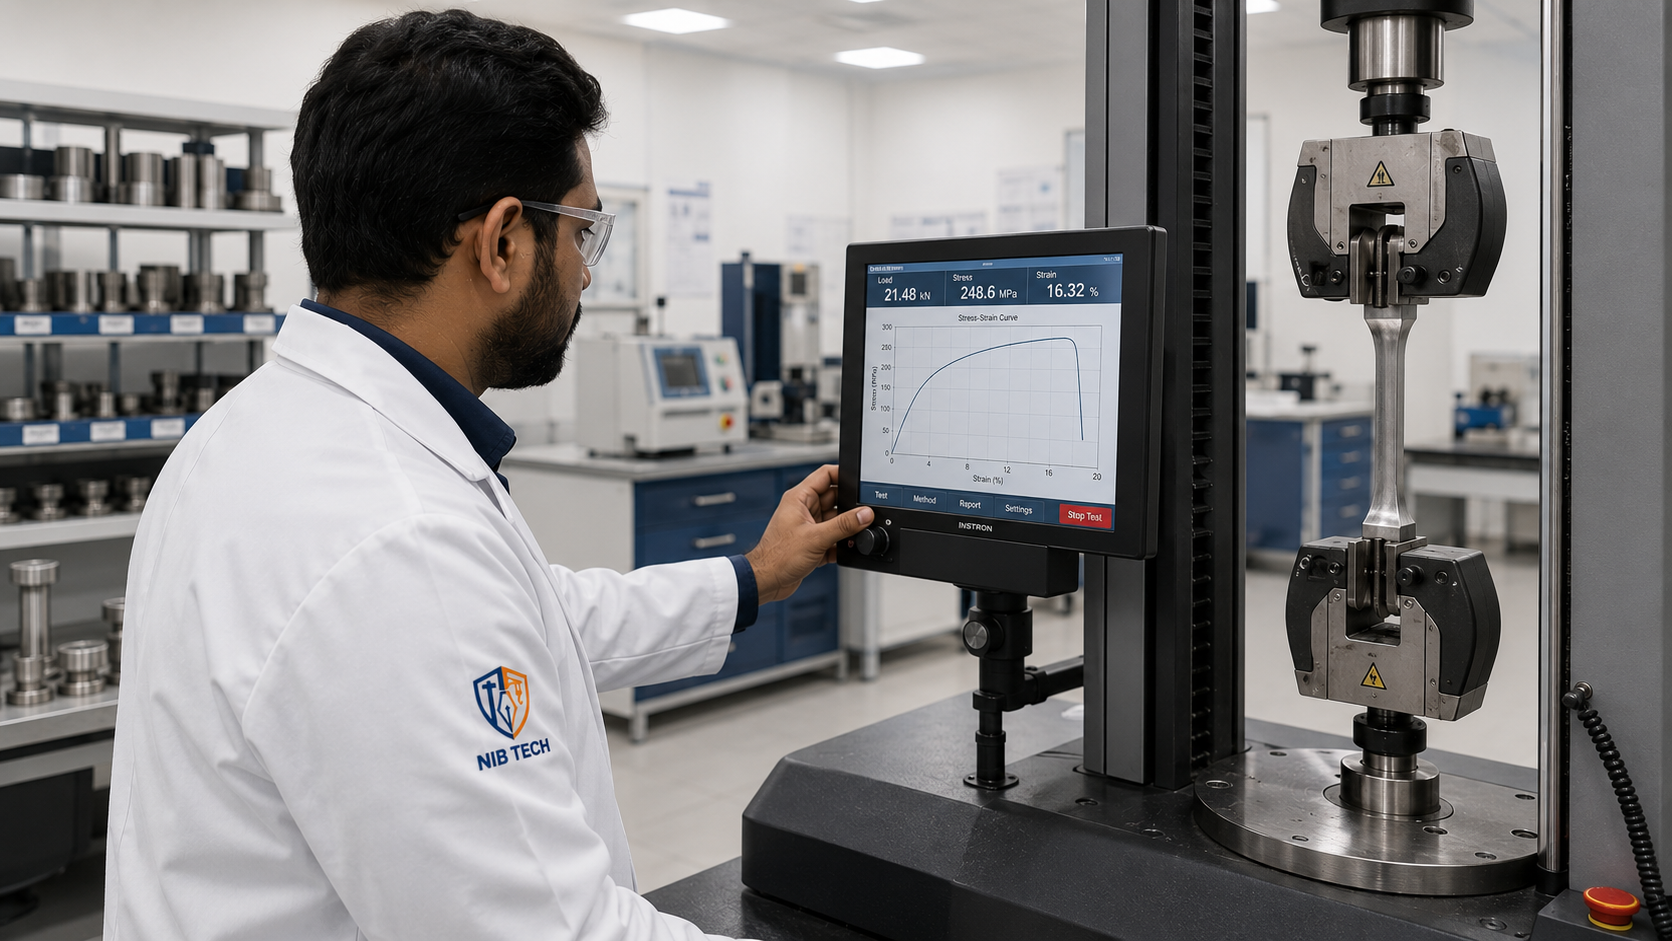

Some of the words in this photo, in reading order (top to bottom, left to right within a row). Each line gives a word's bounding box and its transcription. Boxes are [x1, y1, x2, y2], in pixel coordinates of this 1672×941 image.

[877, 276, 893, 284] Load
[952, 273, 973, 282] Stress
[1036, 270, 1057, 280] Strain
[884, 287, 917, 301] 21.48
[919, 291, 931, 300] kN
[960, 285, 996, 300] 248.6
[999, 289, 1018, 299] MPa
[1047, 283, 1085, 298] 16.32
[1089, 286, 1099, 297] %
[958, 314, 998, 322] Stress-Strain
[999, 314, 1018, 322] Curve
[881, 323, 893, 331] 300
[881, 363, 891, 371] 200
[889, 457, 895, 465] 0
[965, 463, 970, 471] 8
[1003, 466, 1011, 474] 12
[1045, 469, 1053, 477] 16
[1092, 473, 1102, 481] 20
[973, 475, 992, 484] Strain
[875, 491, 888, 499] Test
[913, 495, 937, 505] Method
[1005, 504, 1033, 515] Settings
[1068, 510, 1085, 521] Stop
[958, 521, 993, 532] INSTRON
[477, 749, 509, 771] NIB
[510, 738, 551, 761] TECH
